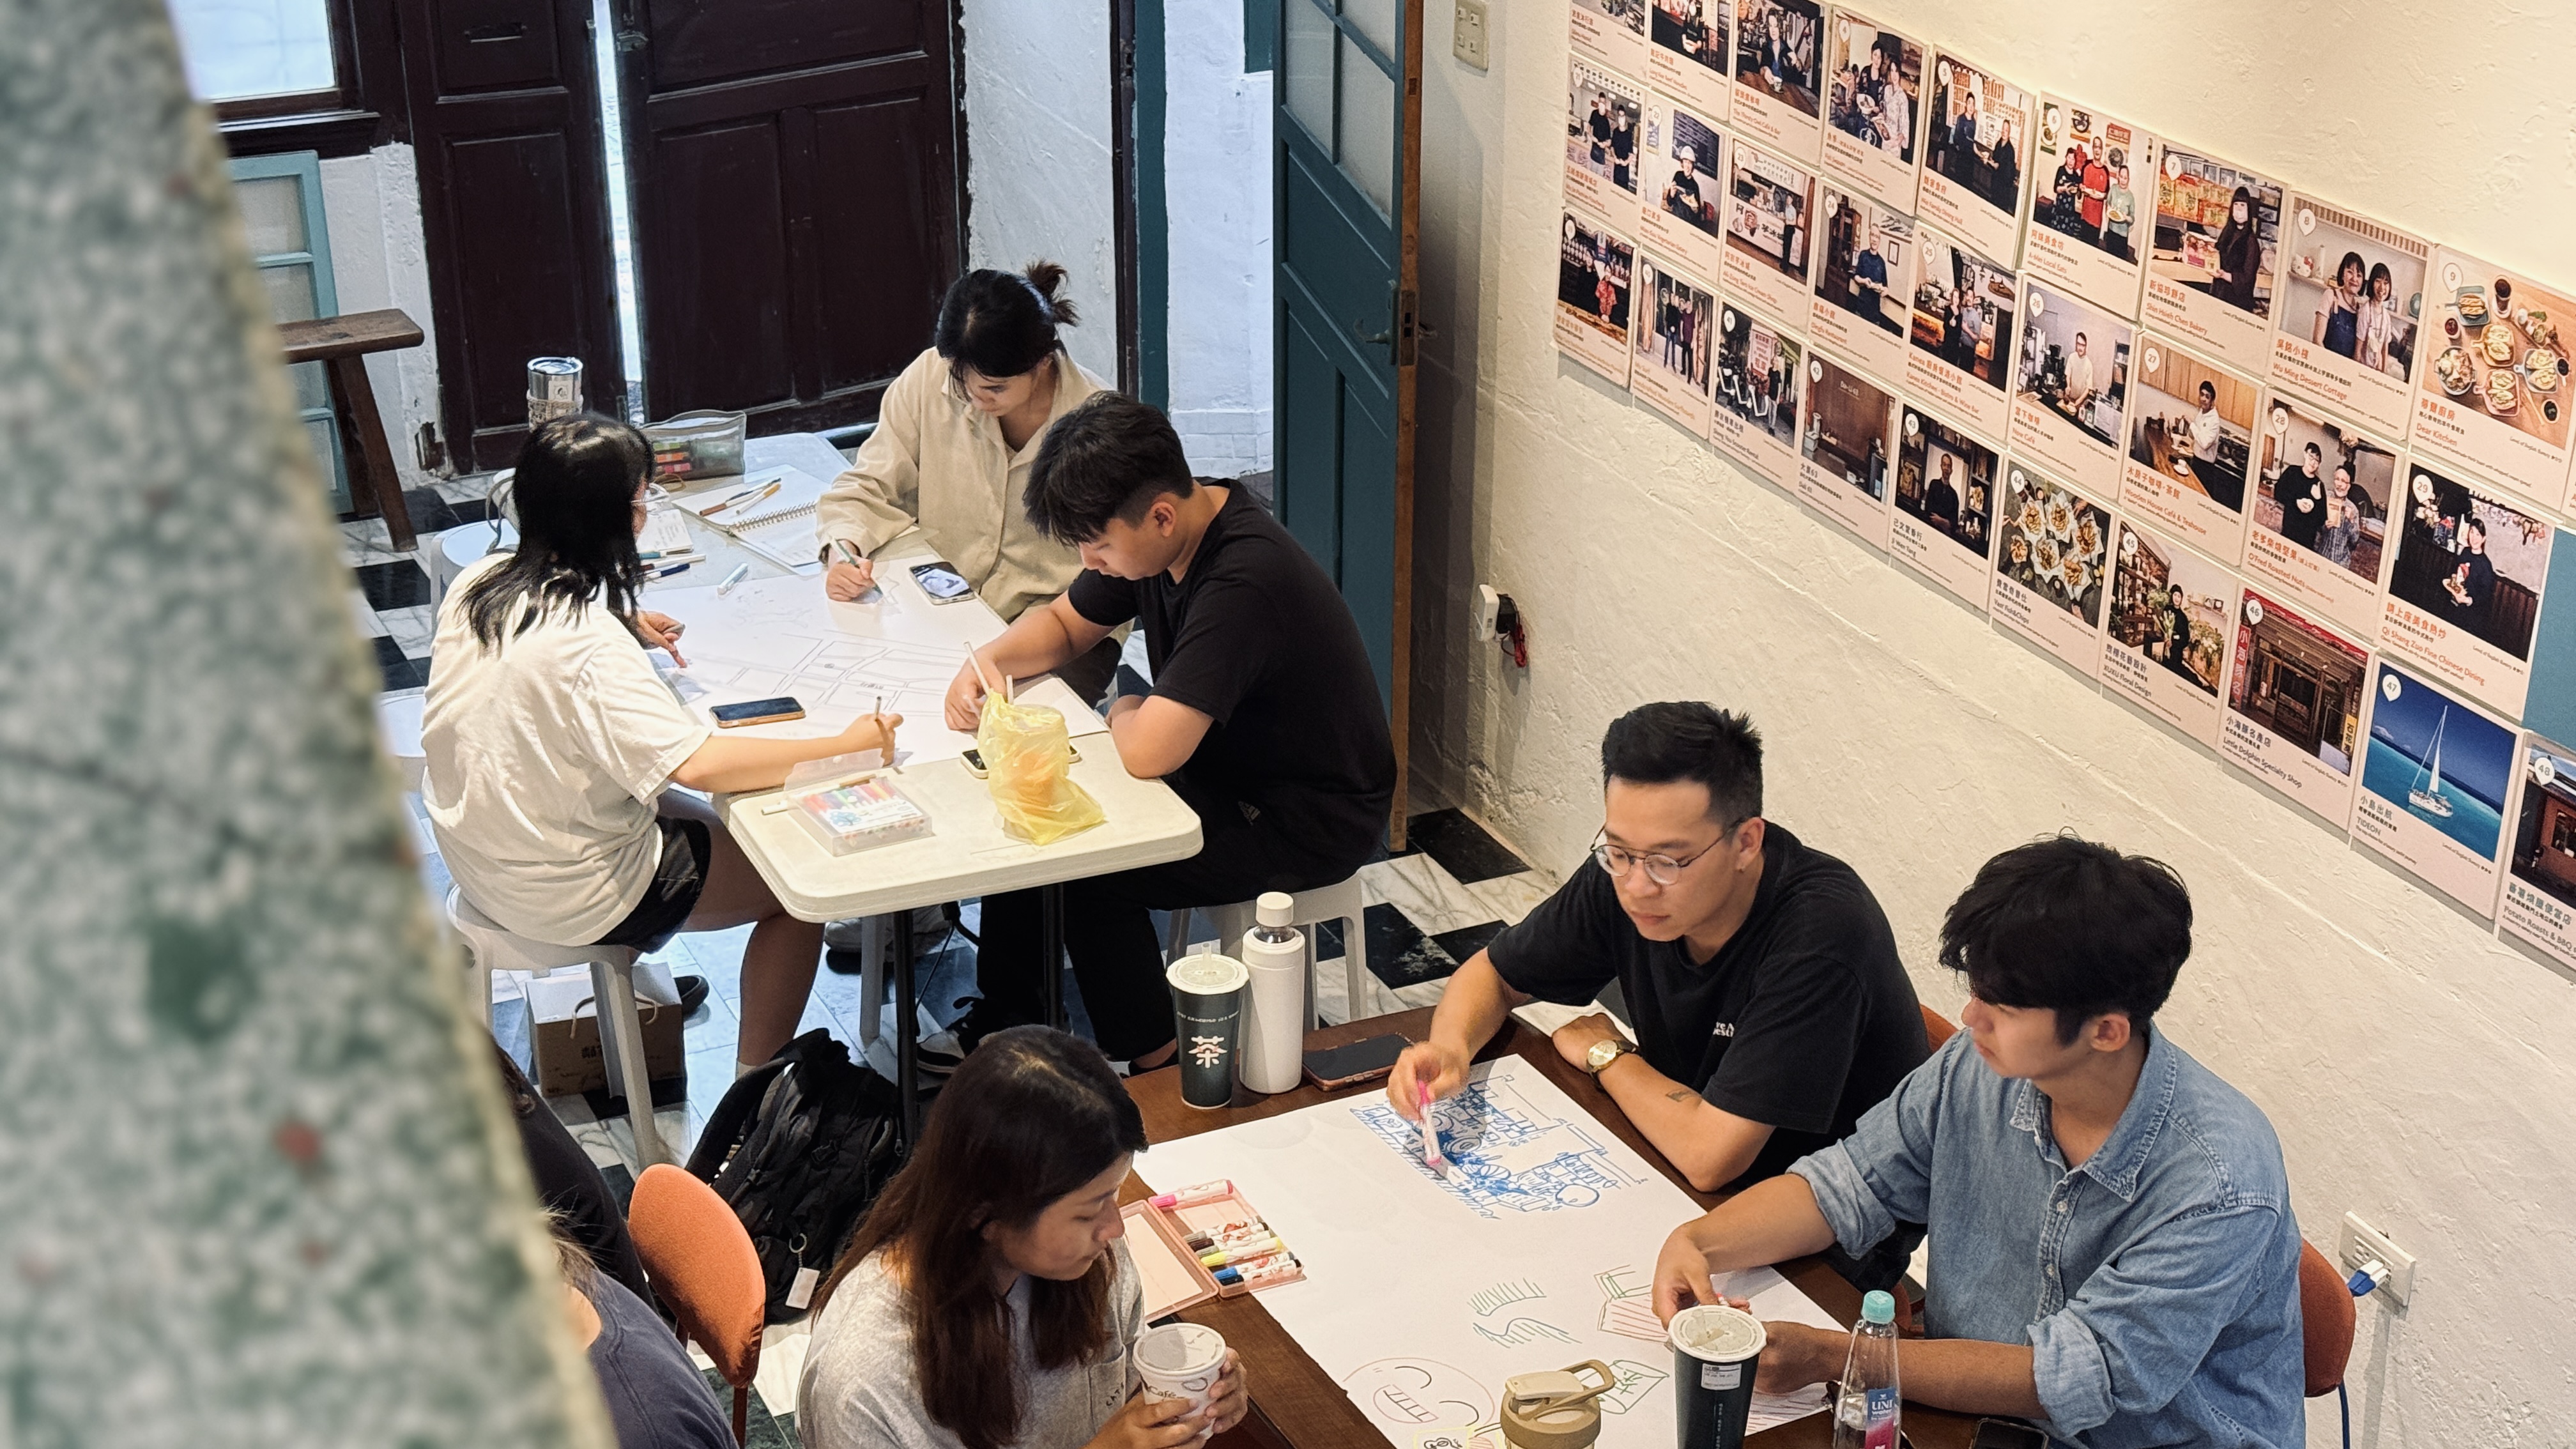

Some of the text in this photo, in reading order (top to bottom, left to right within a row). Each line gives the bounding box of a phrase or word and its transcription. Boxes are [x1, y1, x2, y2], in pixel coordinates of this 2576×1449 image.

[2304, 217, 2310, 225] 8
[2450, 272, 2456, 281] 9
[2147, 355, 2156, 364] 27
[2275, 415, 2285, 425] 28
[2014, 476, 2022, 486] 44
[2417, 482, 2428, 493] 29
[2126, 539, 2135, 548] 45
[2250, 606, 2260, 617] 46
[2387, 682, 2397, 692] 47
[2223, 736, 2301, 790] Little Dolphin Specialty Shop
[2538, 765, 2550, 776] 48
[2504, 904, 2525, 924] Potato
[1188, 1036, 1227, 1068] 茶
[1872, 1399, 1892, 1411] UNI
